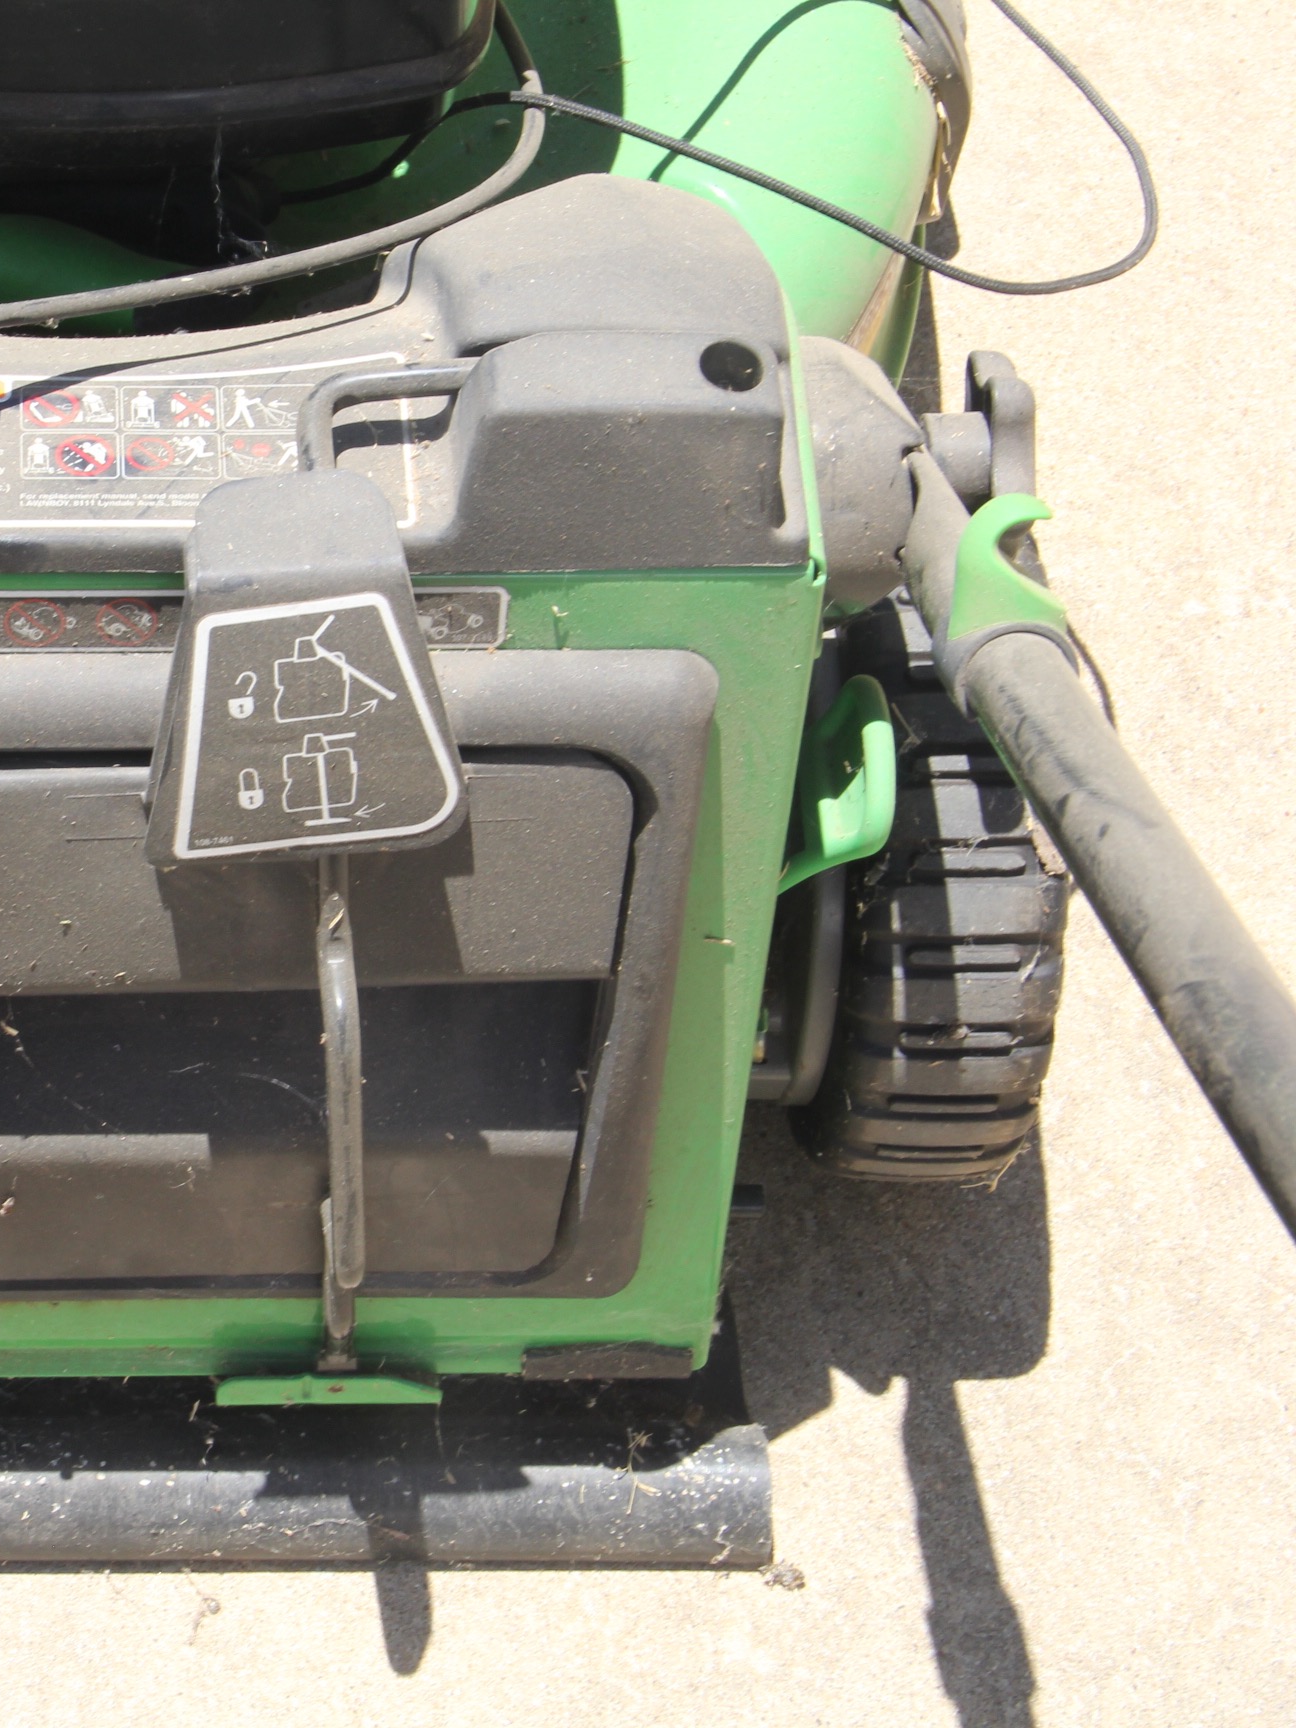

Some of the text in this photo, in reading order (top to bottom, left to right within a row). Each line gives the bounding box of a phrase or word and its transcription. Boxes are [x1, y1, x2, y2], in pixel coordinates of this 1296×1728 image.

[19, 492, 37, 500] For
[38, 492, 100, 501] replacement
[101, 492, 141, 501] manual,
[142, 492, 167, 500] send
[97, 500, 136, 509] Lyndale
